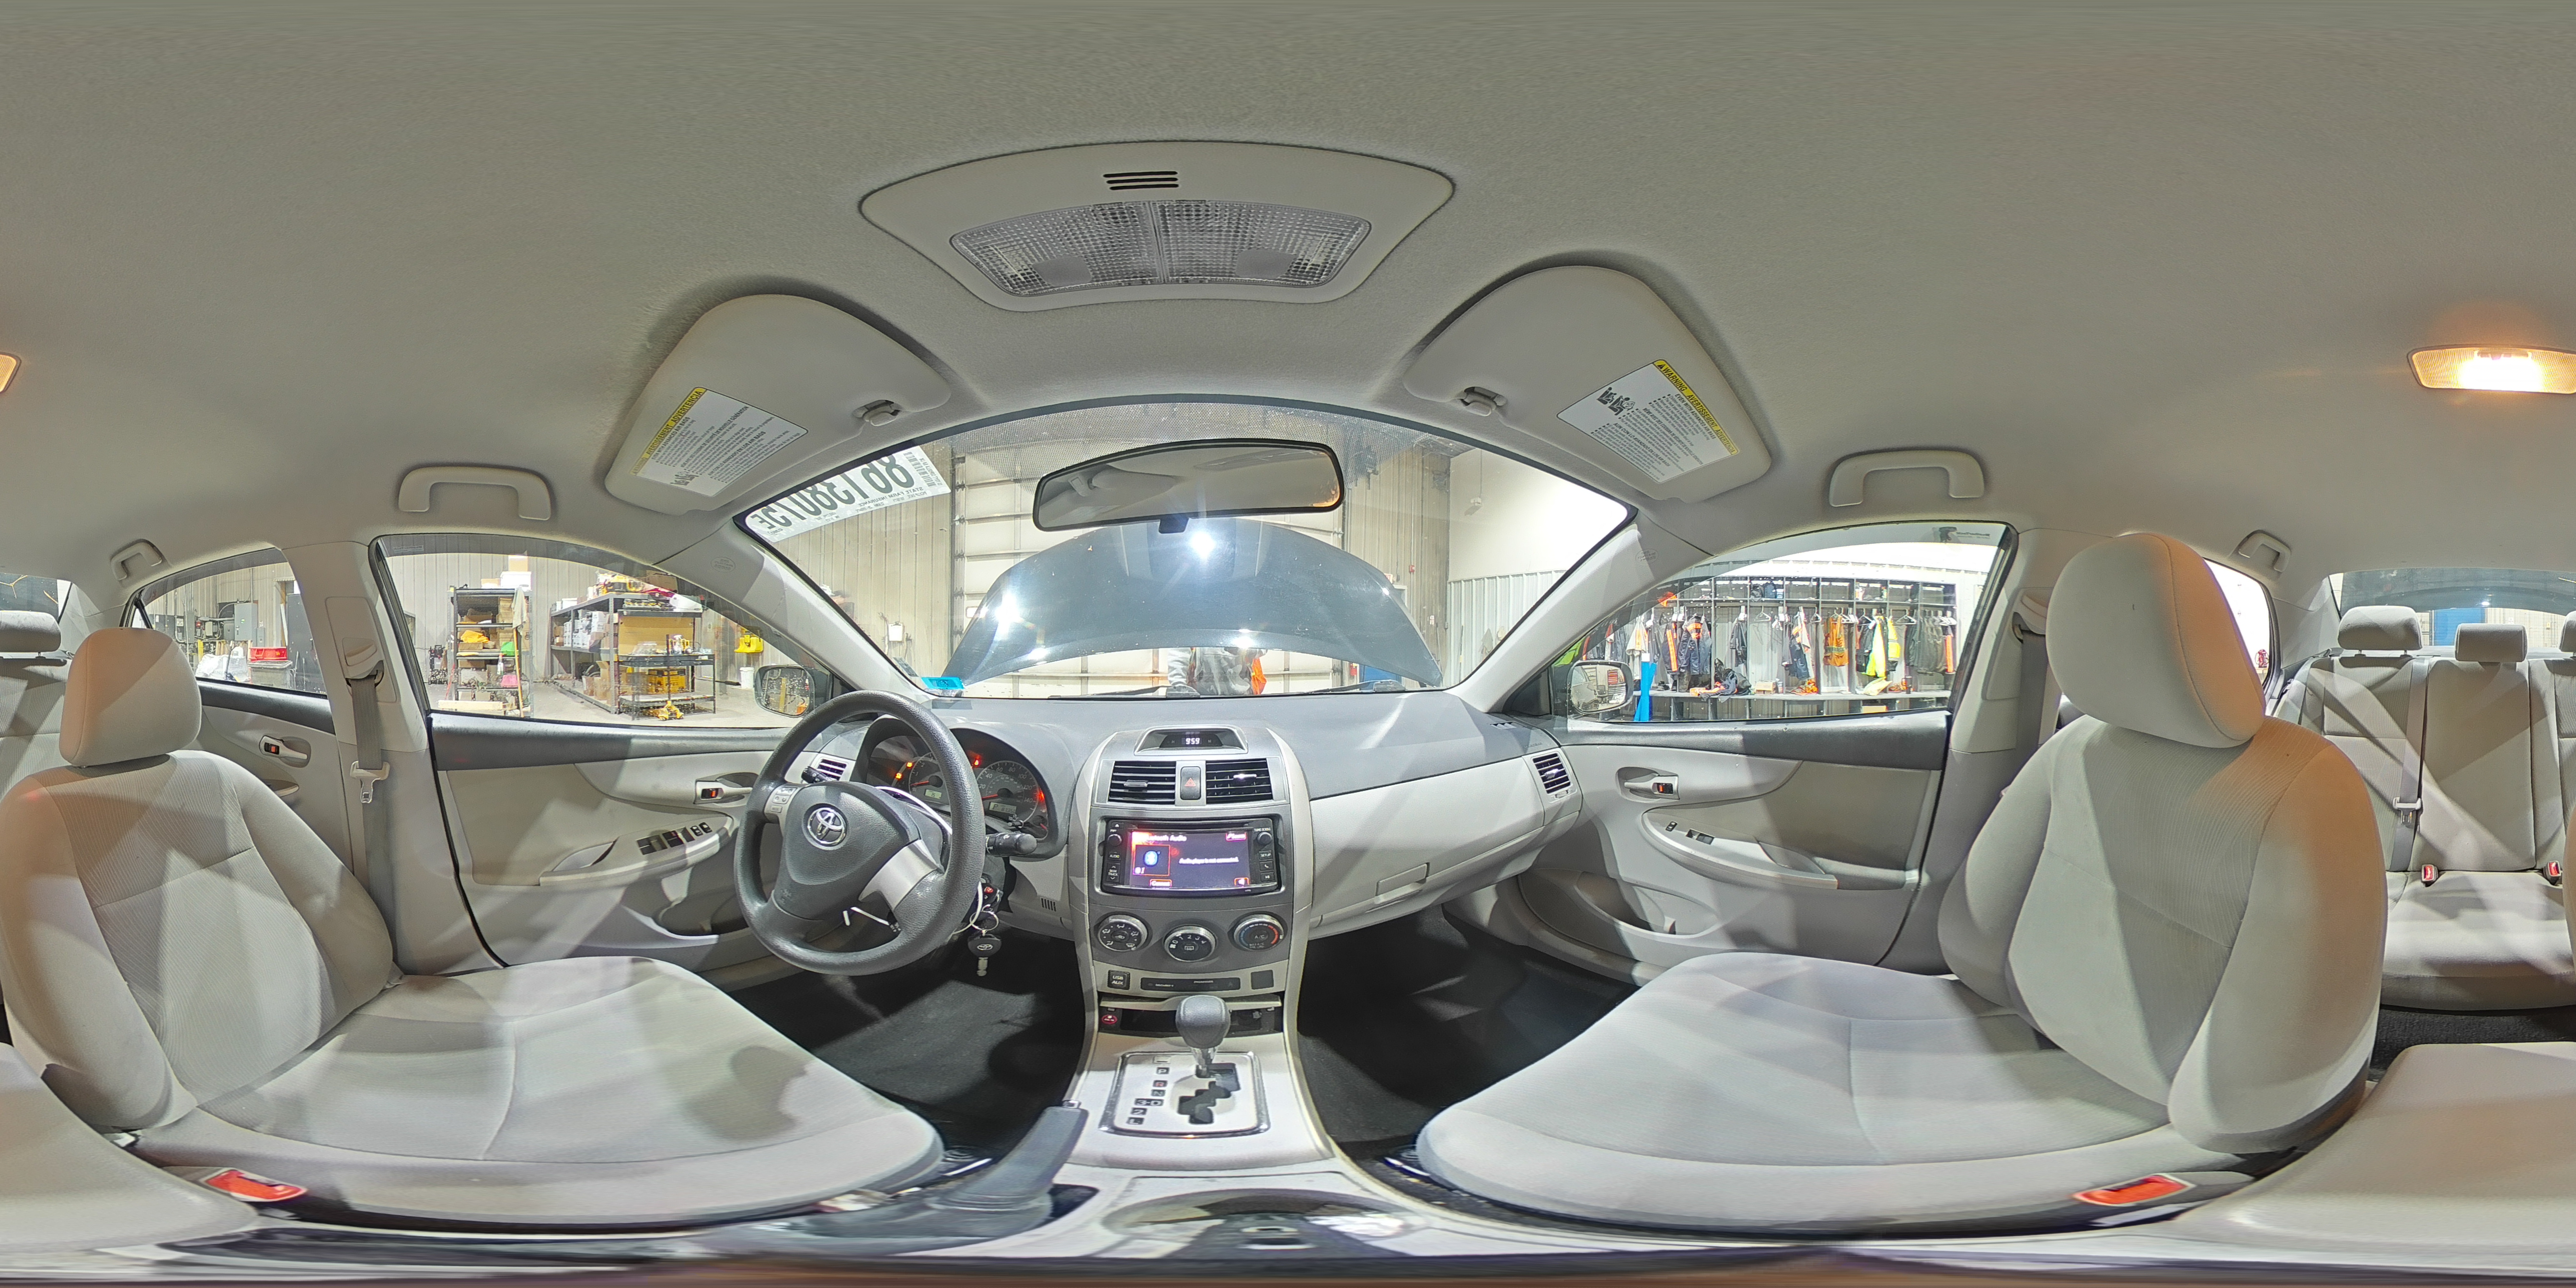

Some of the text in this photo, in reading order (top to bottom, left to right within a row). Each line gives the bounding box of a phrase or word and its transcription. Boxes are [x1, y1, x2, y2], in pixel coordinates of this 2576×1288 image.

[644, 425, 674, 455] AVERTISSEMENT
[671, 389, 703, 423] ADVERTENCIA
[678, 416, 690, 426] BAGS
[1661, 367, 1687, 392] WARNING
[1684, 393, 1718, 428] AVERTISSEMENT
[1713, 428, 1737, 452] ADVERTENCIA
[1674, 393, 1686, 403] EVEN
[1682, 402, 1693, 411] WITH
